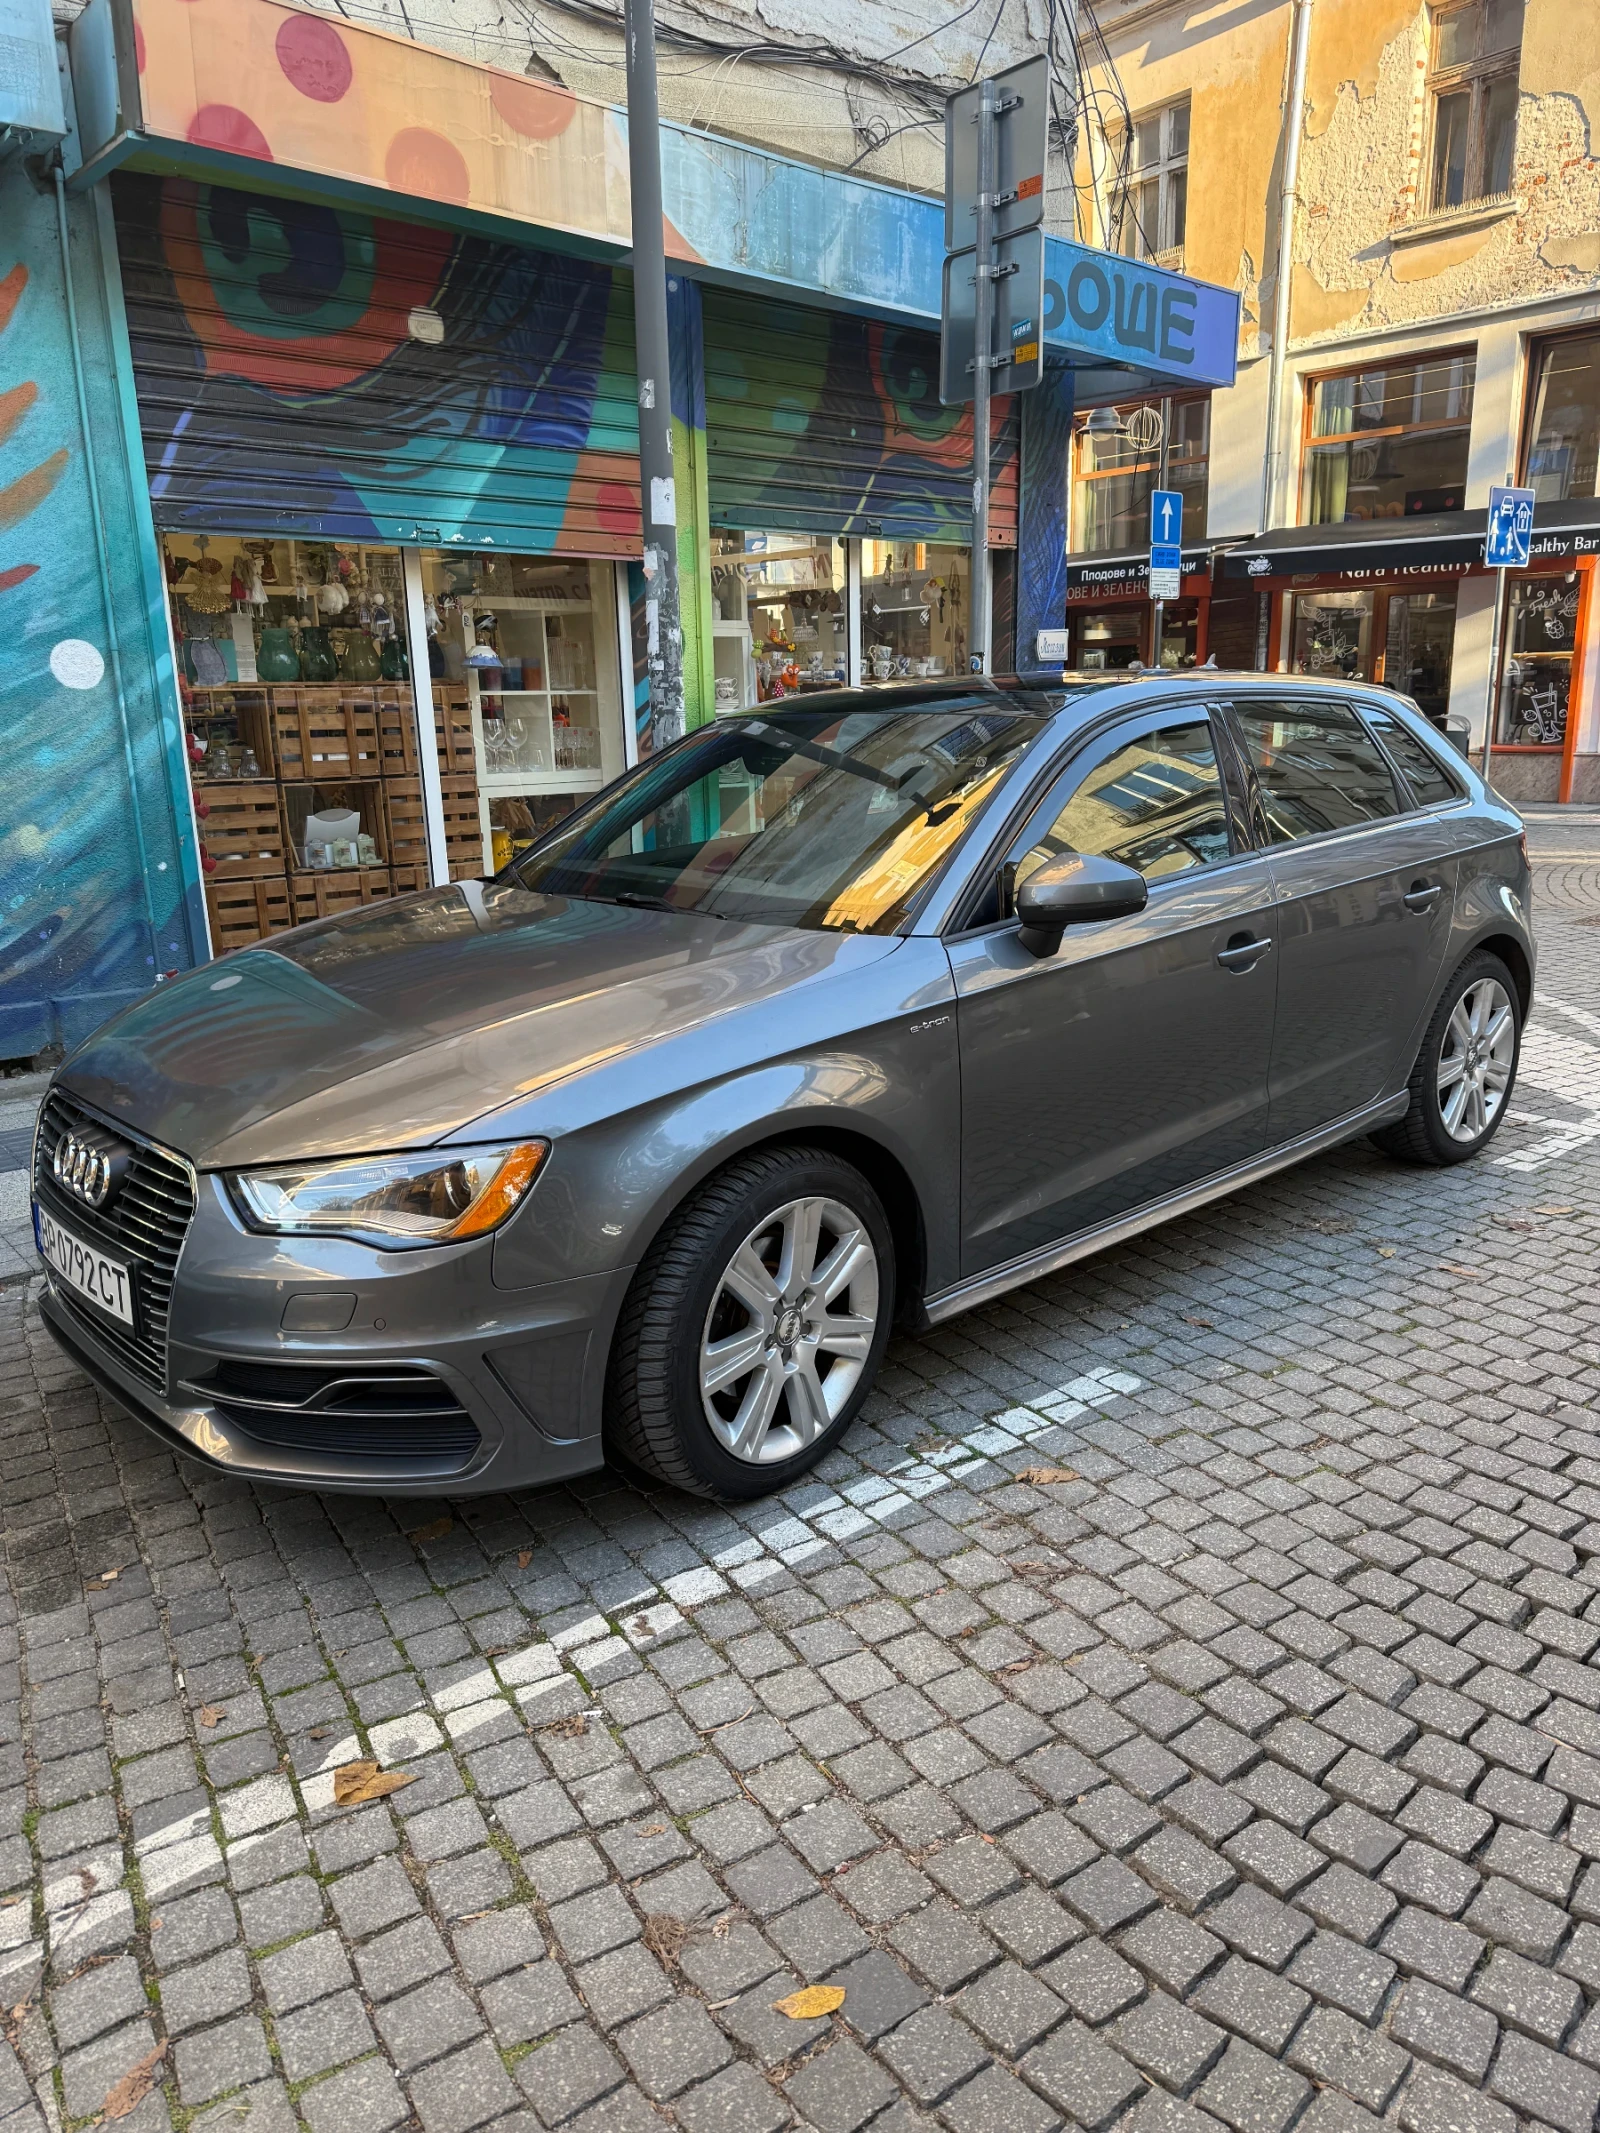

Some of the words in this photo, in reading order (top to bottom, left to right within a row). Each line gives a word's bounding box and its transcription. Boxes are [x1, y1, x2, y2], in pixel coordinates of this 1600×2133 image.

[1529, 537, 1570, 556] ealthy
[1574, 536, 1599, 550] Bar
[1081, 569, 1126, 582] Плодове
[1128, 568, 1135, 577] и
[1091, 585, 1100, 598] И
[1529, 588, 1564, 618] Fresh
[910, 1015, 950, 1034] e-tron
